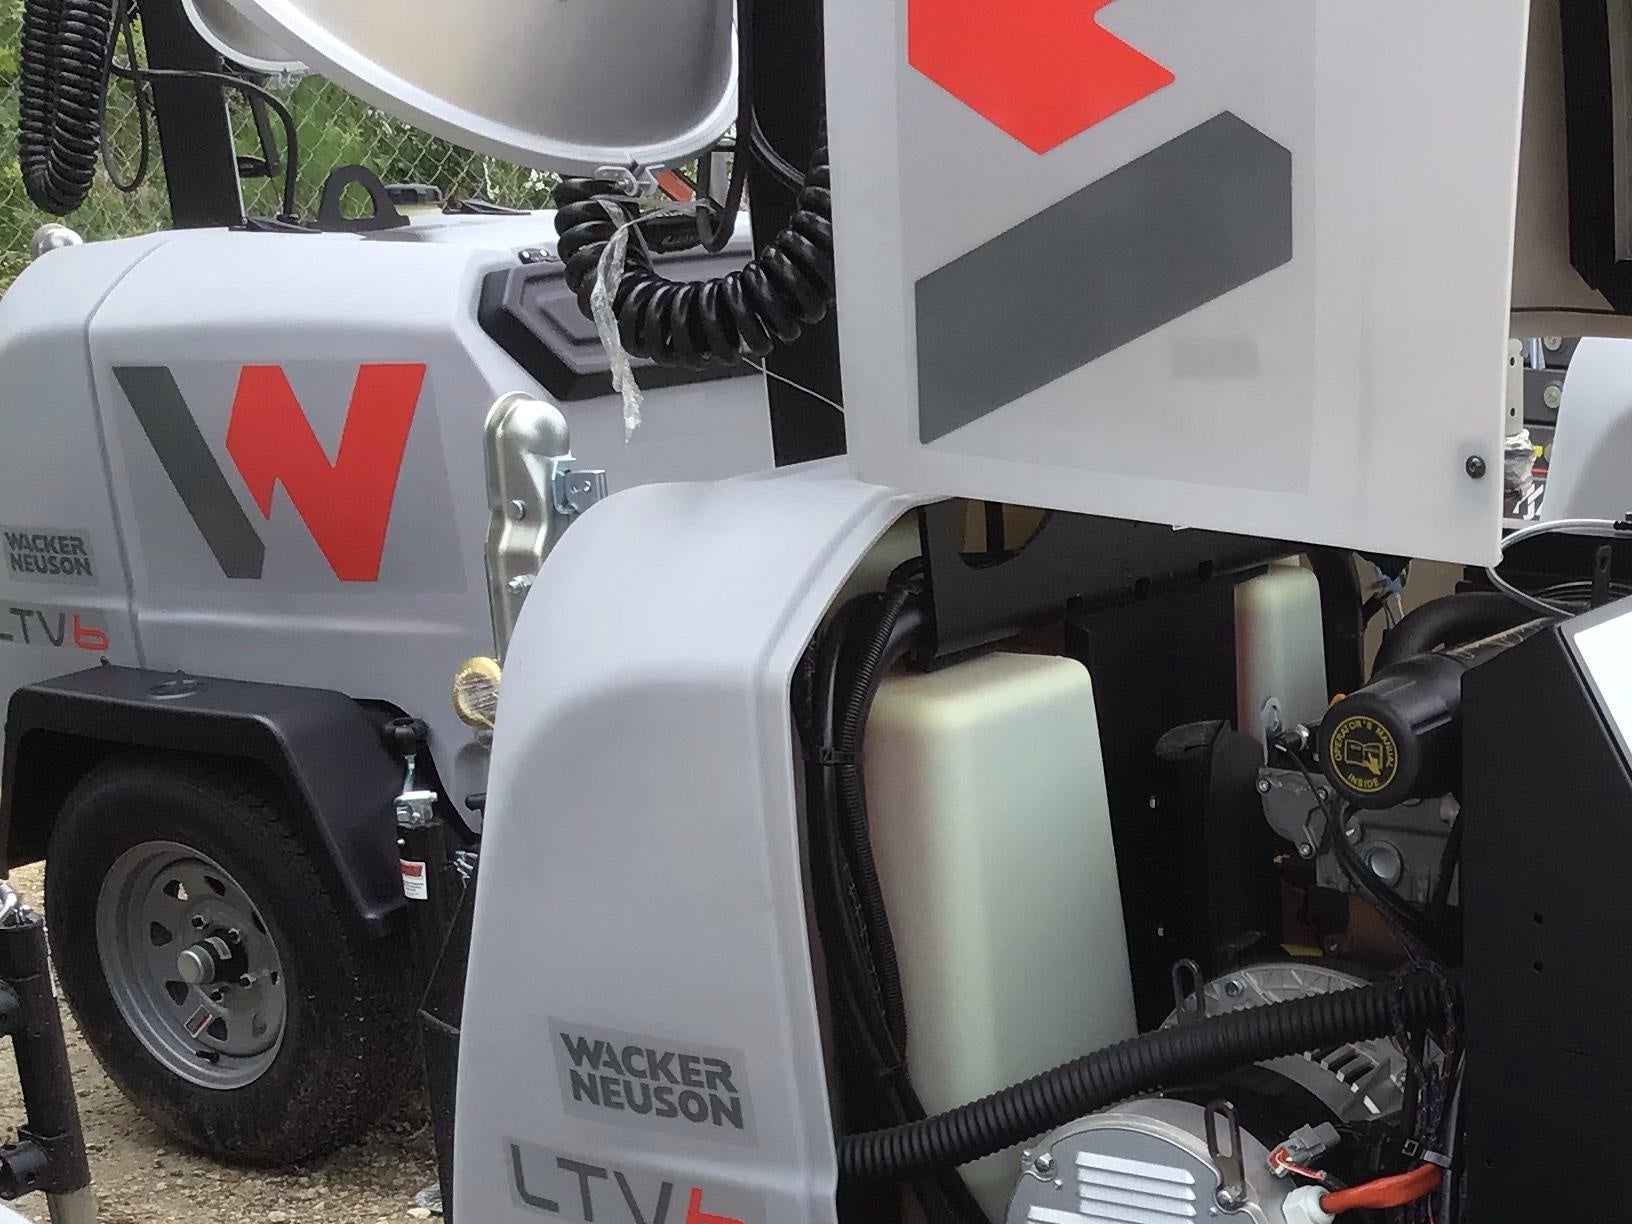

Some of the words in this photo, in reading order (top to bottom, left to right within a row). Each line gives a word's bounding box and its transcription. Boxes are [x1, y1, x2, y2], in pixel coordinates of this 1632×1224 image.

[4, 531, 87, 556] WACKER
[10, 552, 93, 576] NEUSON
[1347, 772, 1380, 788] INSIDE
[560, 1032, 738, 1093] WACKER
[569, 1068, 744, 1130] NEUSON
